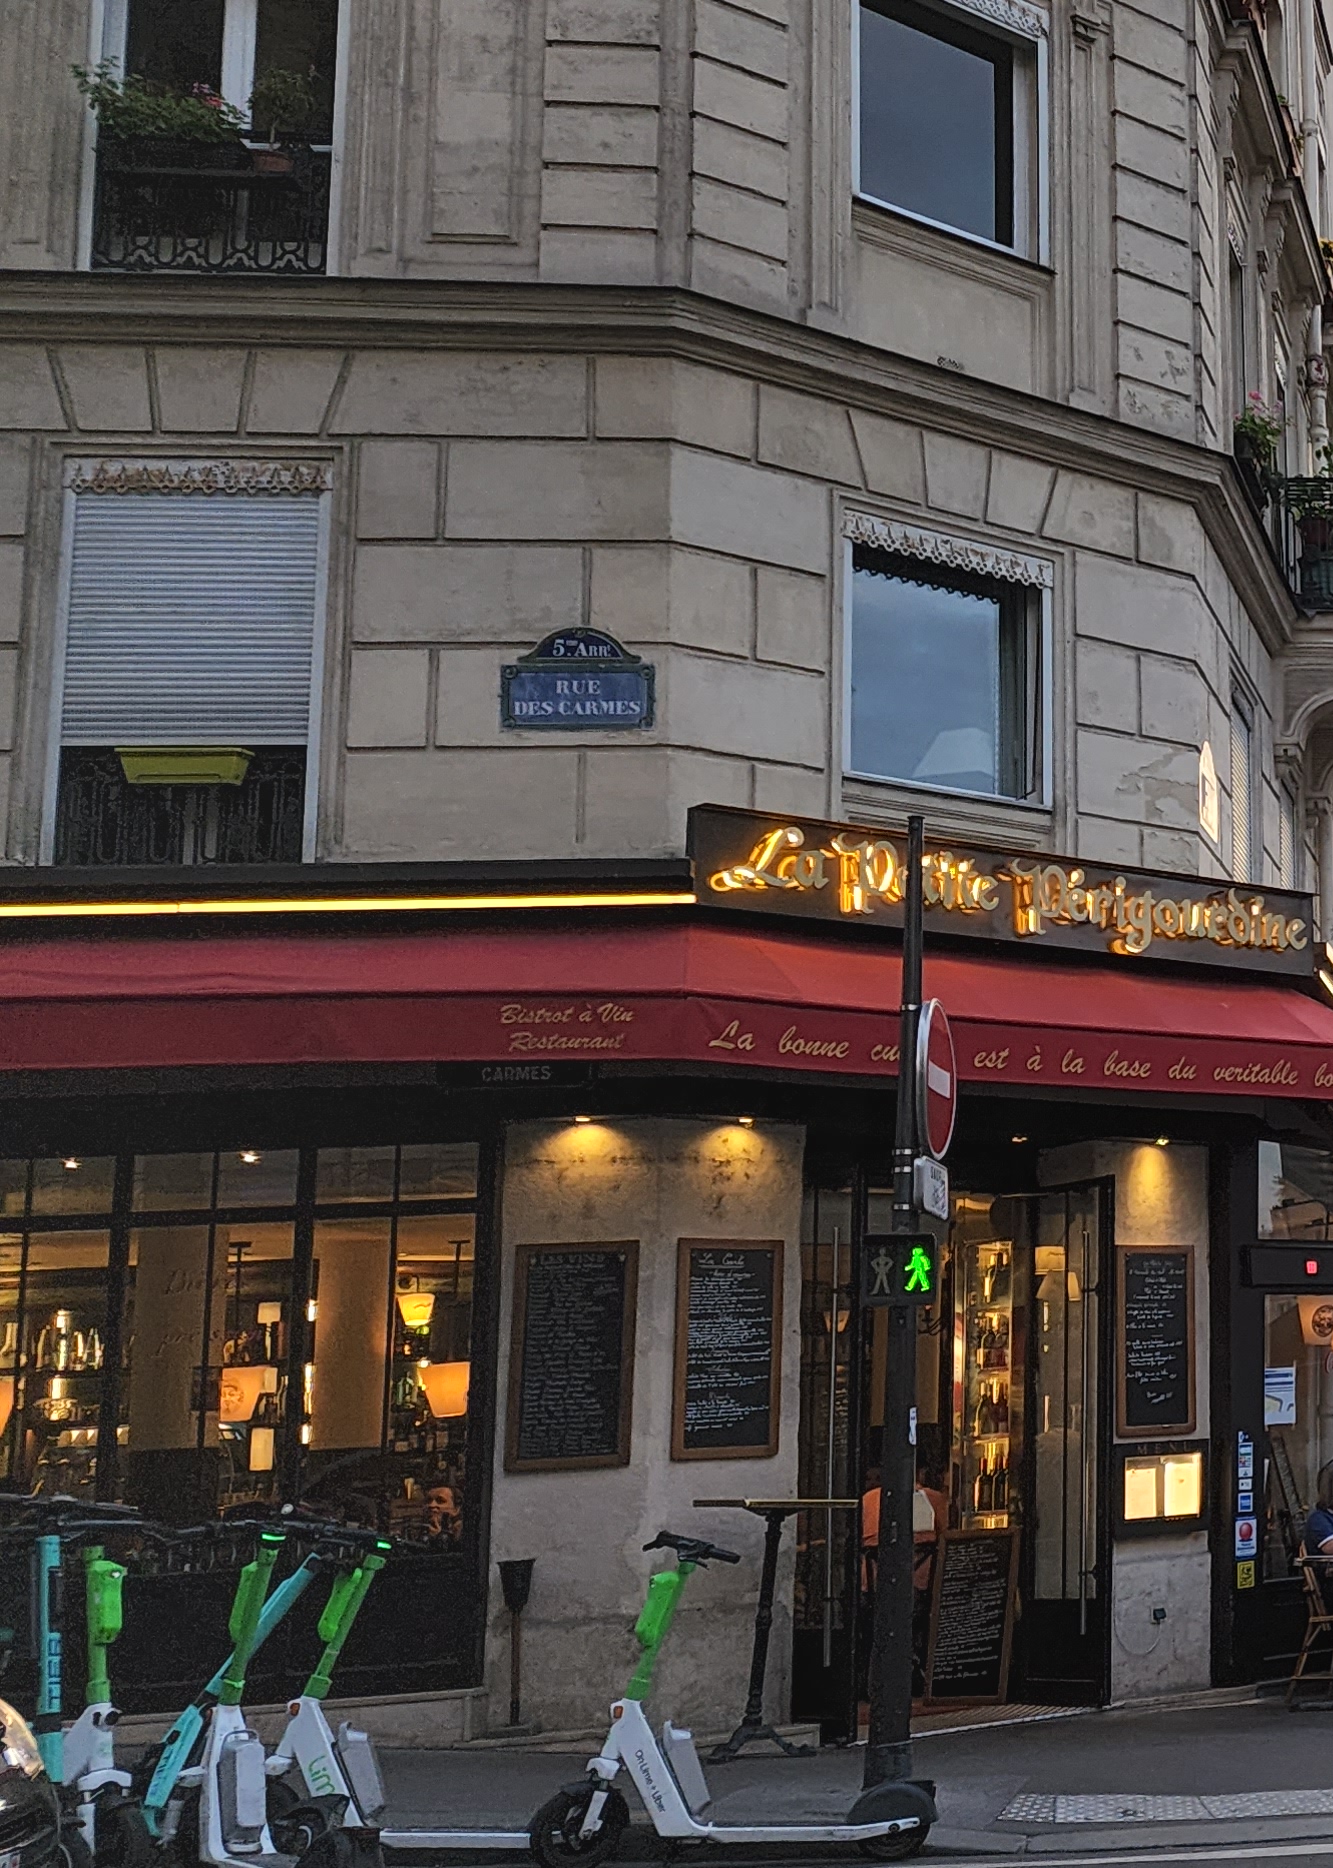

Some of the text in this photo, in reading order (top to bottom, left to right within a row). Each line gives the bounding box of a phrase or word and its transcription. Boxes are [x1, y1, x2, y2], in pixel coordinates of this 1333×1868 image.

[556, 679, 601, 695] RUE
[514, 700, 641, 716] DES CARMES
[710, 826, 829, 892] La
[1010, 857, 1308, 955] Périgourdine
[500, 1002, 634, 1026] Bistrot à Vin
[508, 1030, 624, 1053] Restaurant
[708, 1019, 756, 1052] La
[777, 1025, 850, 1059] bonne
[481, 1065, 552, 1082] CARMES
[973, 1046, 1010, 1070] est
[1027, 1045, 1043, 1072] à
[1061, 1047, 1087, 1075] la
[1103, 1050, 1152, 1080] base
[1168, 1056, 1198, 1080] du
[1212, 1056, 1300, 1086] veritable
